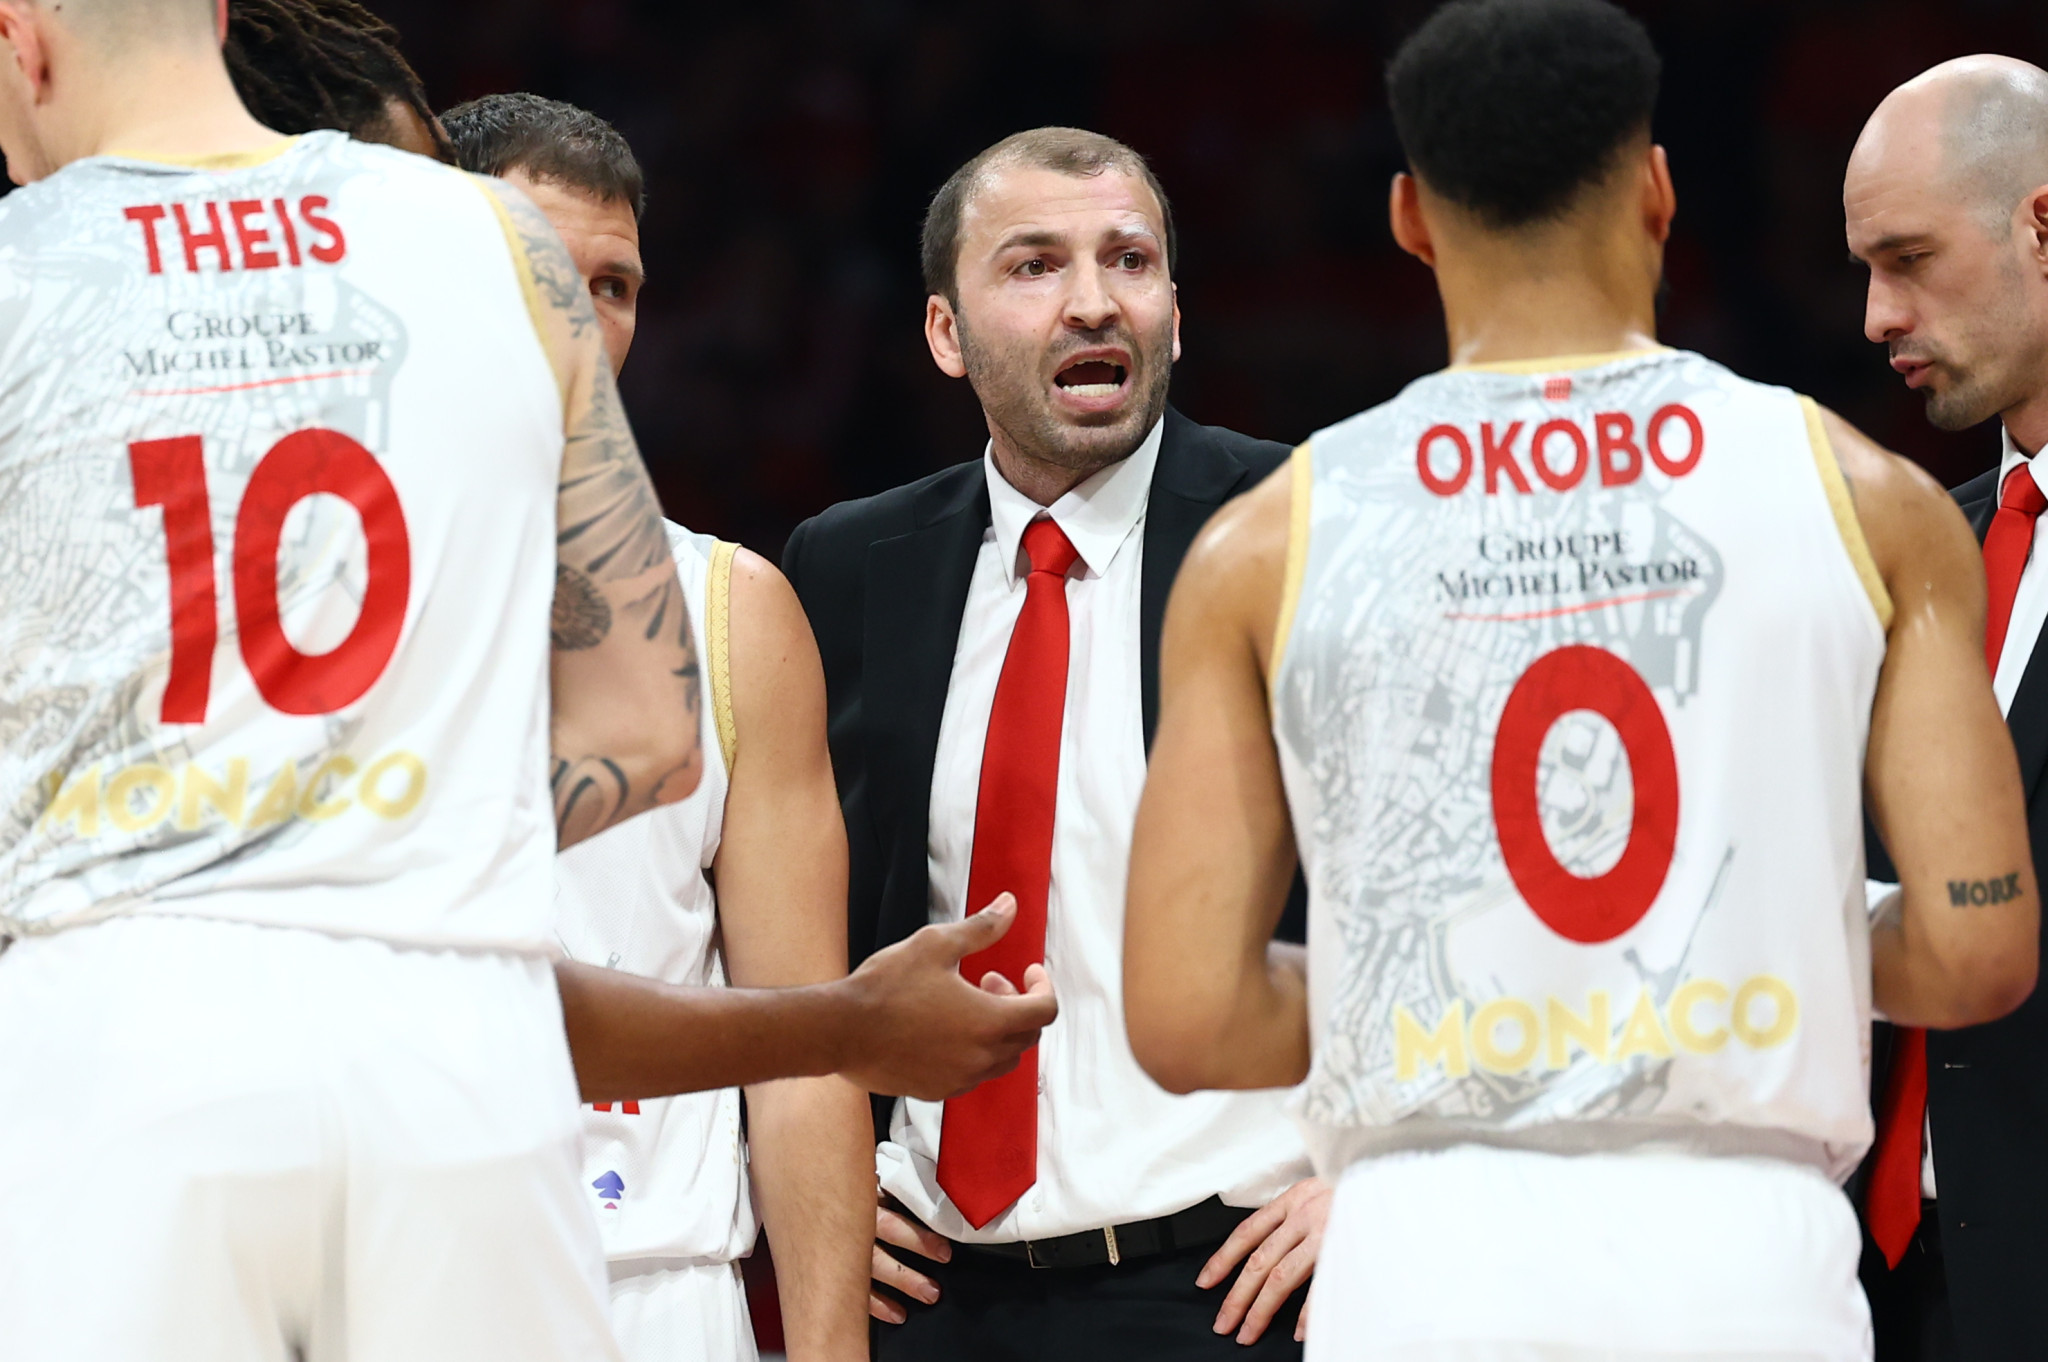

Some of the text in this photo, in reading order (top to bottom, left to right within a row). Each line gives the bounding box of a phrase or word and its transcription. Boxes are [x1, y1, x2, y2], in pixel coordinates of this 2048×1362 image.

[123, 194, 347, 275] THEIS
[123, 339, 384, 380] MICHEL PASTOR
[166, 310, 319, 341] GROUPE
[1416, 402, 1705, 497] OKOBO
[127, 427, 412, 725] 10
[1436, 558, 1699, 602] MICHEL PASTOR
[1478, 530, 1629, 564] GROUPE
[39, 750, 428, 835] MONACO
[1489, 643, 1681, 946] 0
[1946, 871, 2023, 908] WORK
[1393, 973, 1799, 1082] MONACO
